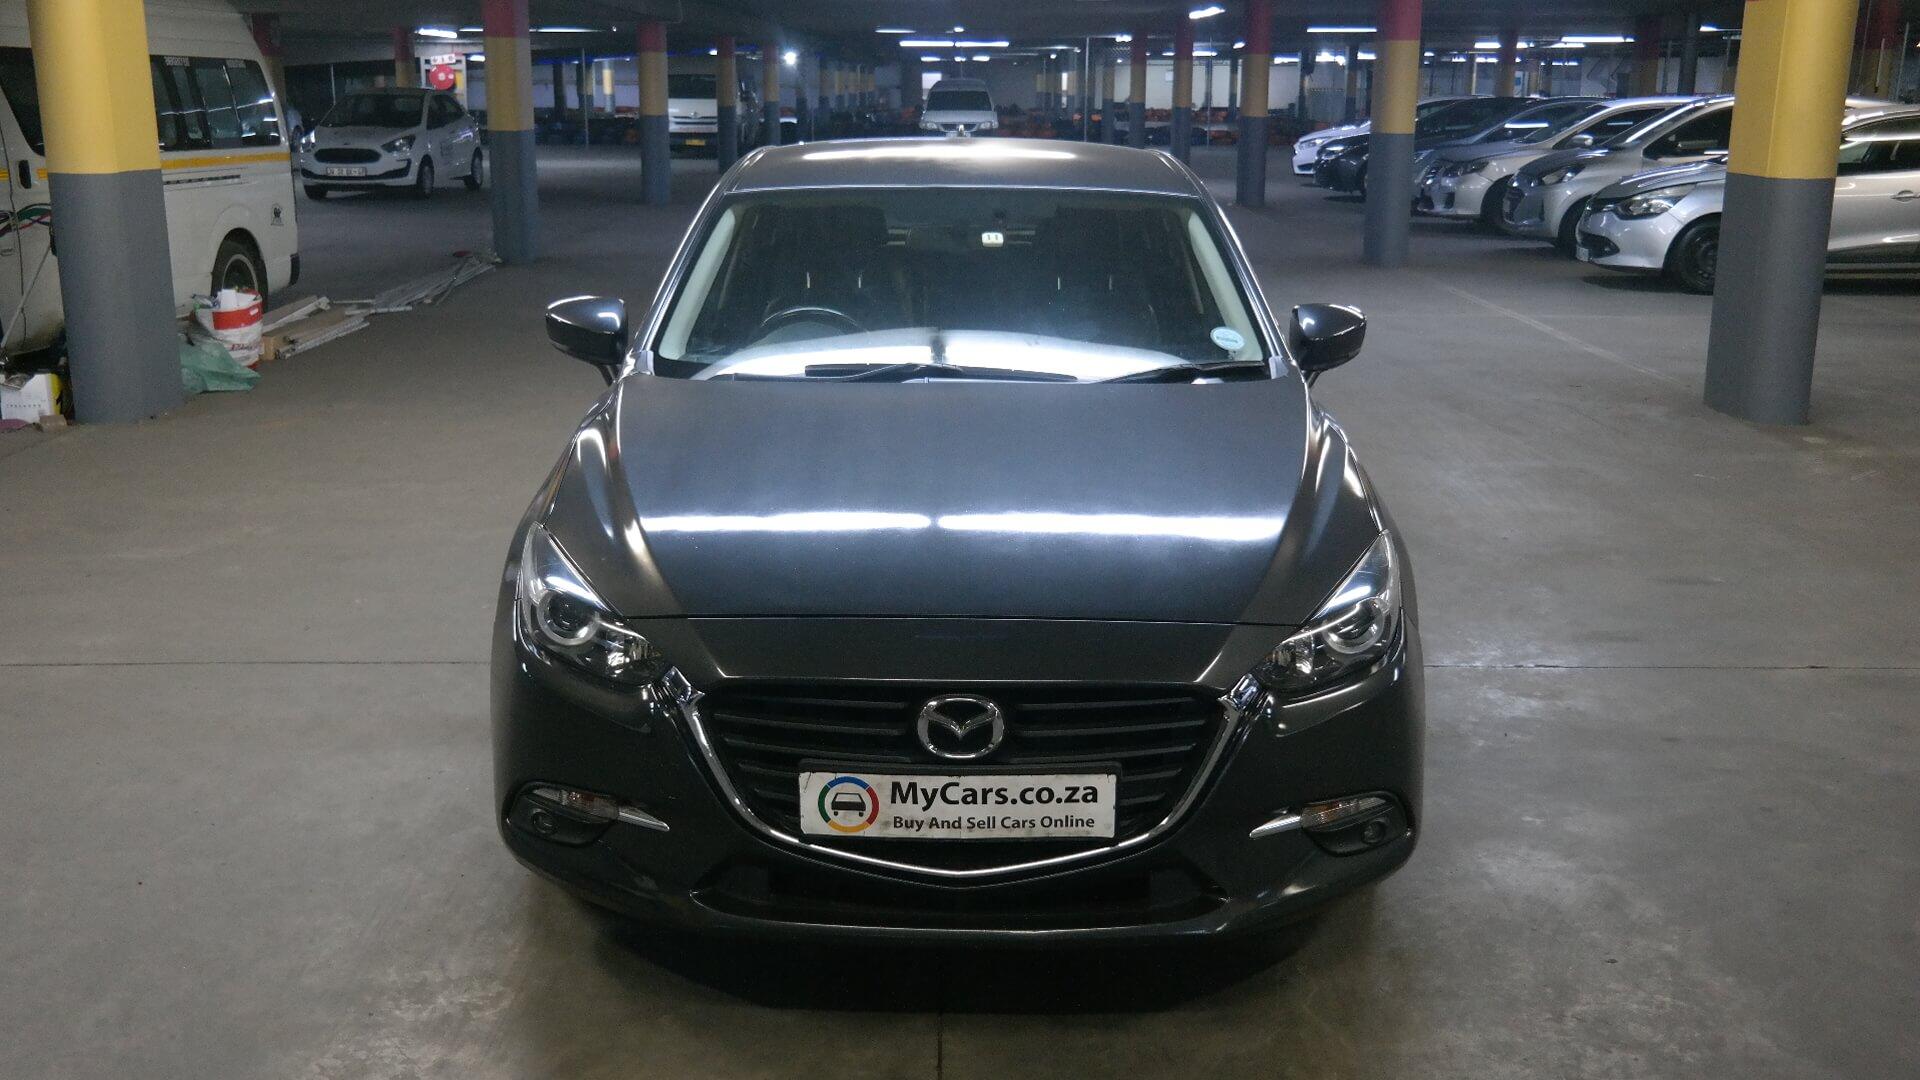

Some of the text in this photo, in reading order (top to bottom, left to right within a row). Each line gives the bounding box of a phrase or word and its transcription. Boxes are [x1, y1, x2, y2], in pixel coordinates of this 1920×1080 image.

[890, 781, 1098, 812] MyCars.co.za
[893, 815, 1095, 832] Buy And Sell Cars Online
